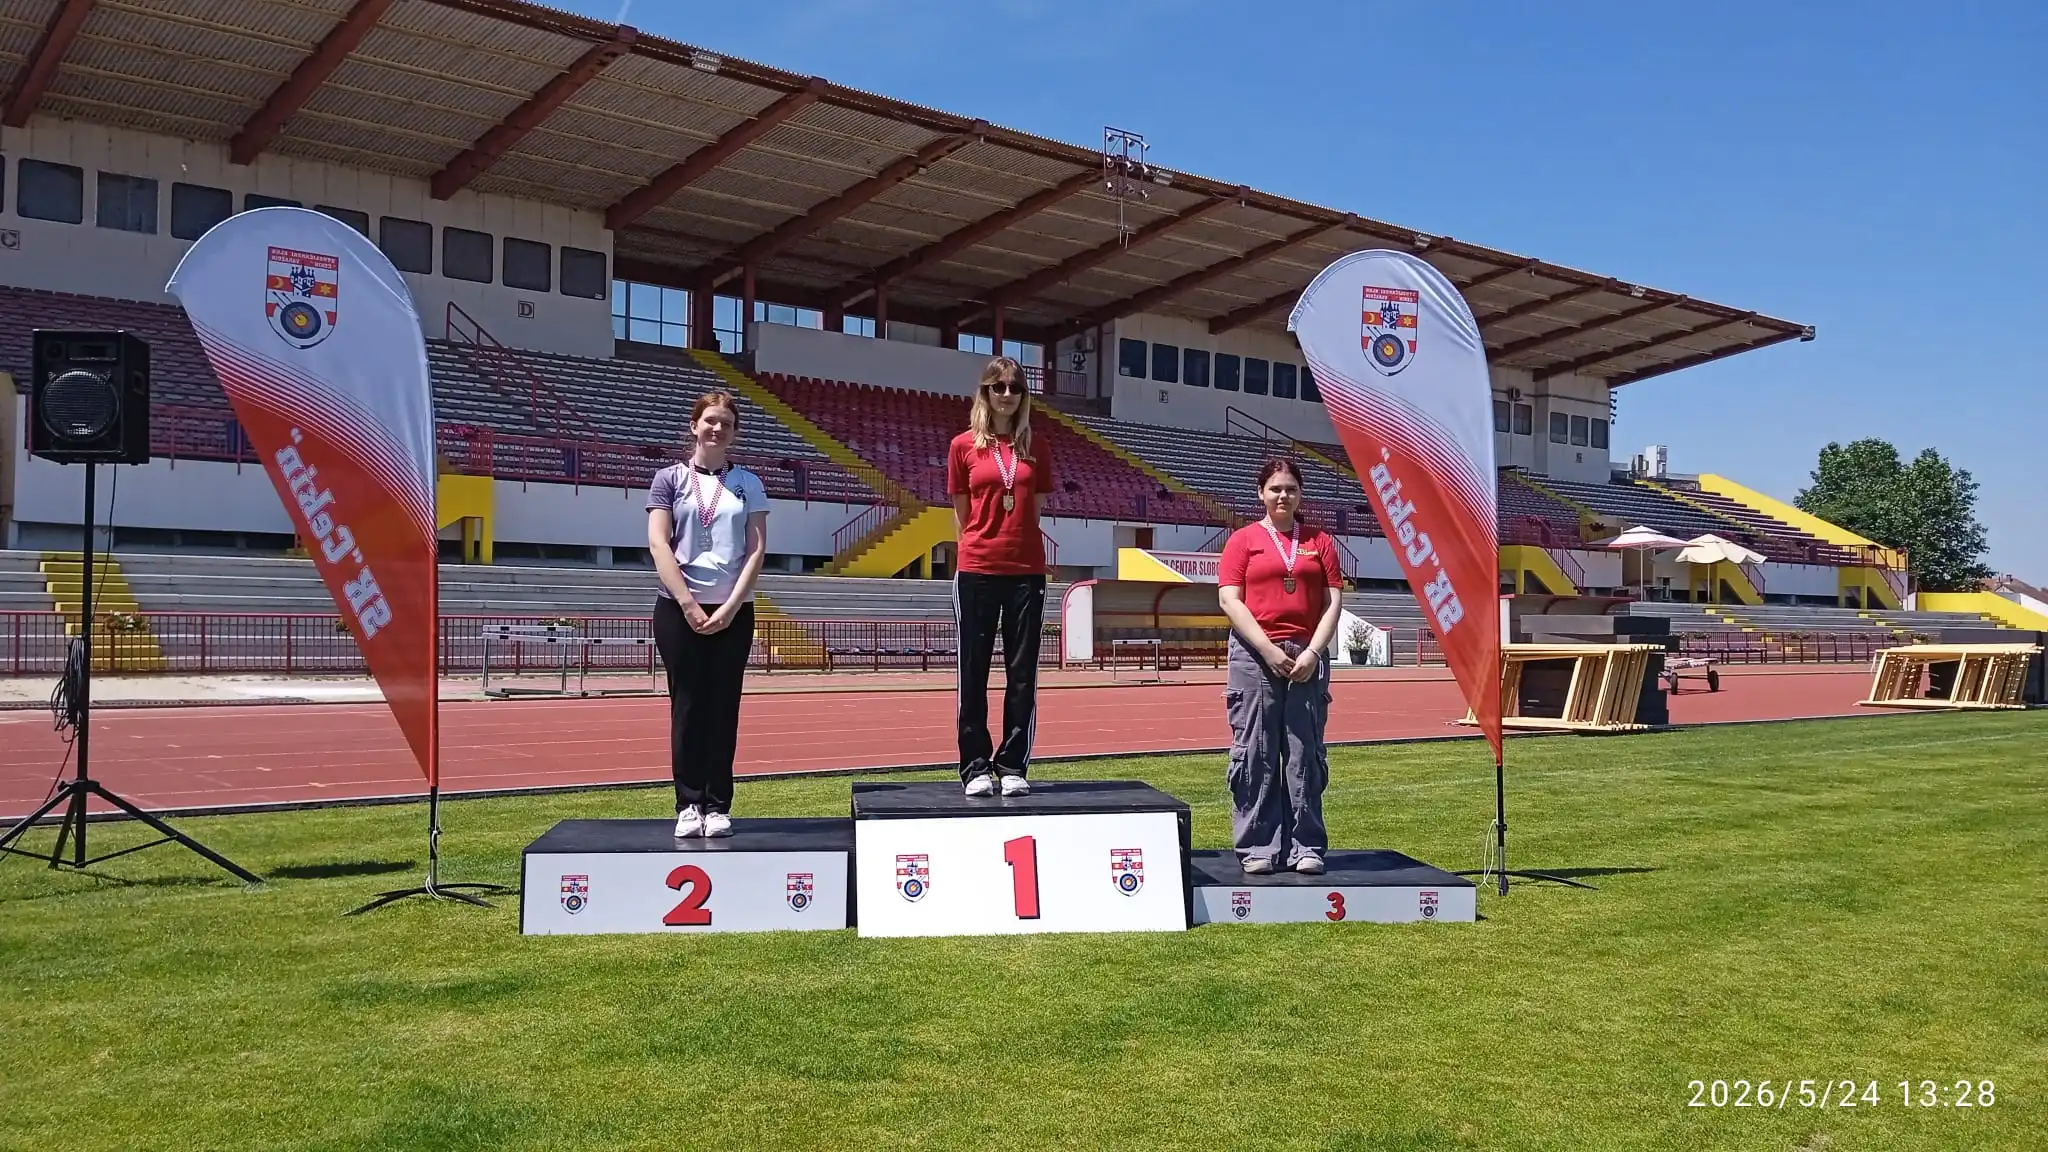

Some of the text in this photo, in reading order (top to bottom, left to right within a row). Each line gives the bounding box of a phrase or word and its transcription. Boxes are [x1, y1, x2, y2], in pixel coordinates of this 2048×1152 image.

[1, 231, 17, 247] C
[519, 302, 533, 316] D
[1004, 835, 1041, 920] 1
[662, 864, 712, 926] 2
[1325, 891, 1346, 921] 3
